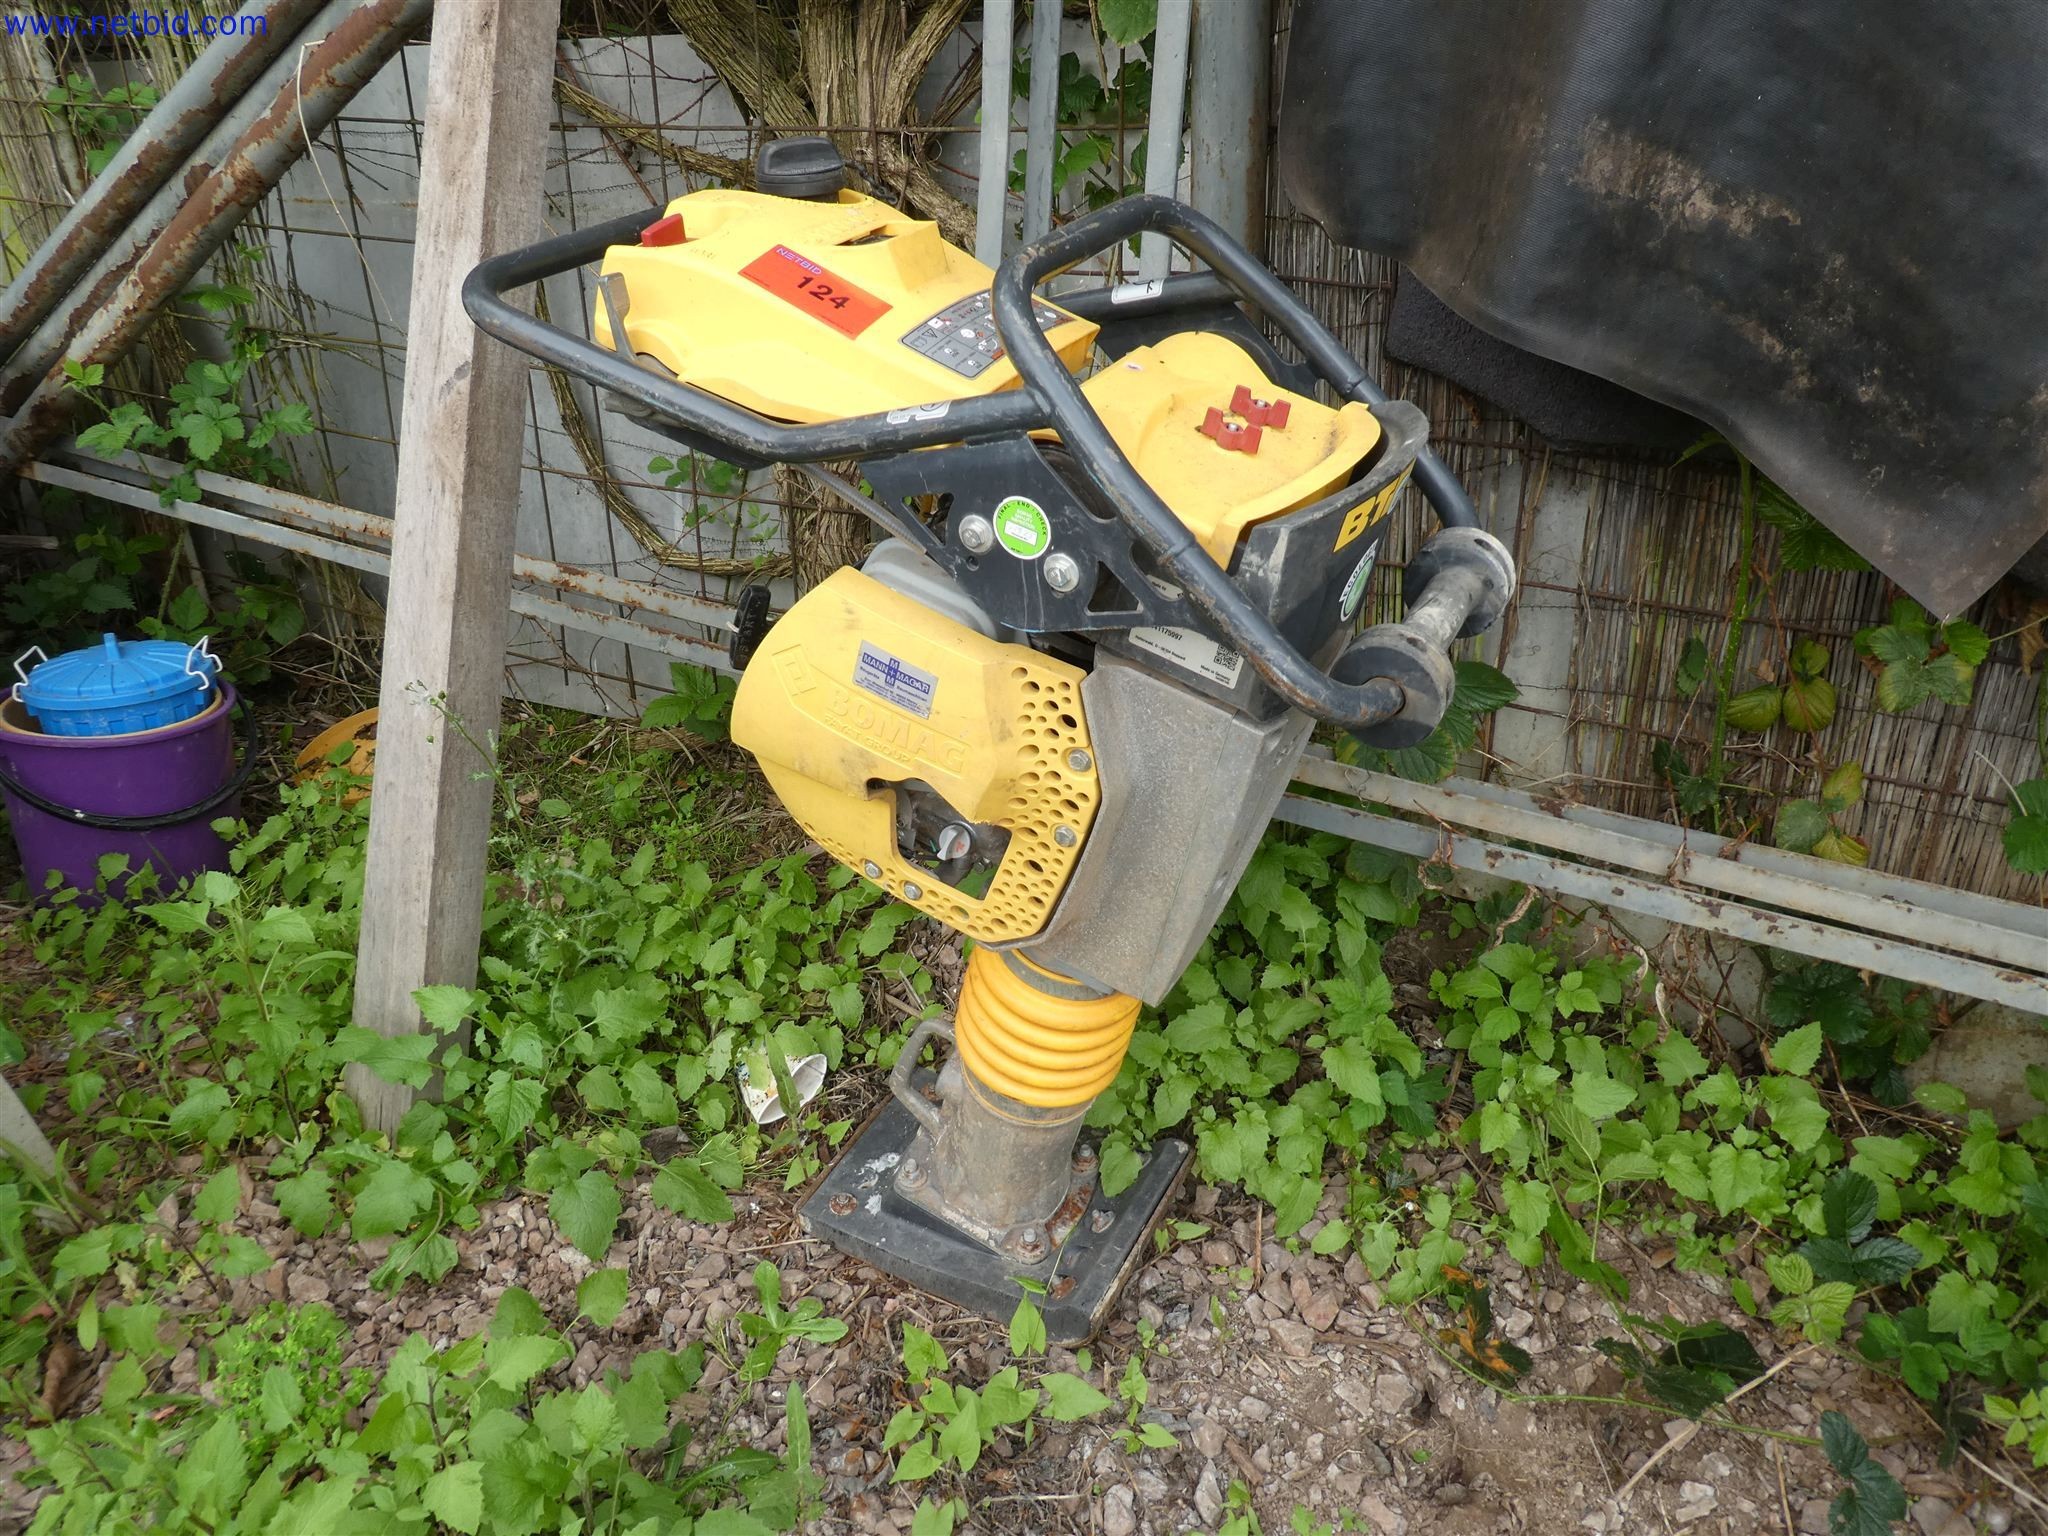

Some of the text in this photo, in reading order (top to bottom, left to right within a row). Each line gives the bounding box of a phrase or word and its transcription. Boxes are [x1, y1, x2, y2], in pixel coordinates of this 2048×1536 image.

[776, 247, 822, 275] NETBID
[797, 275, 851, 309] 124
[826, 686, 967, 774] BOMAG
